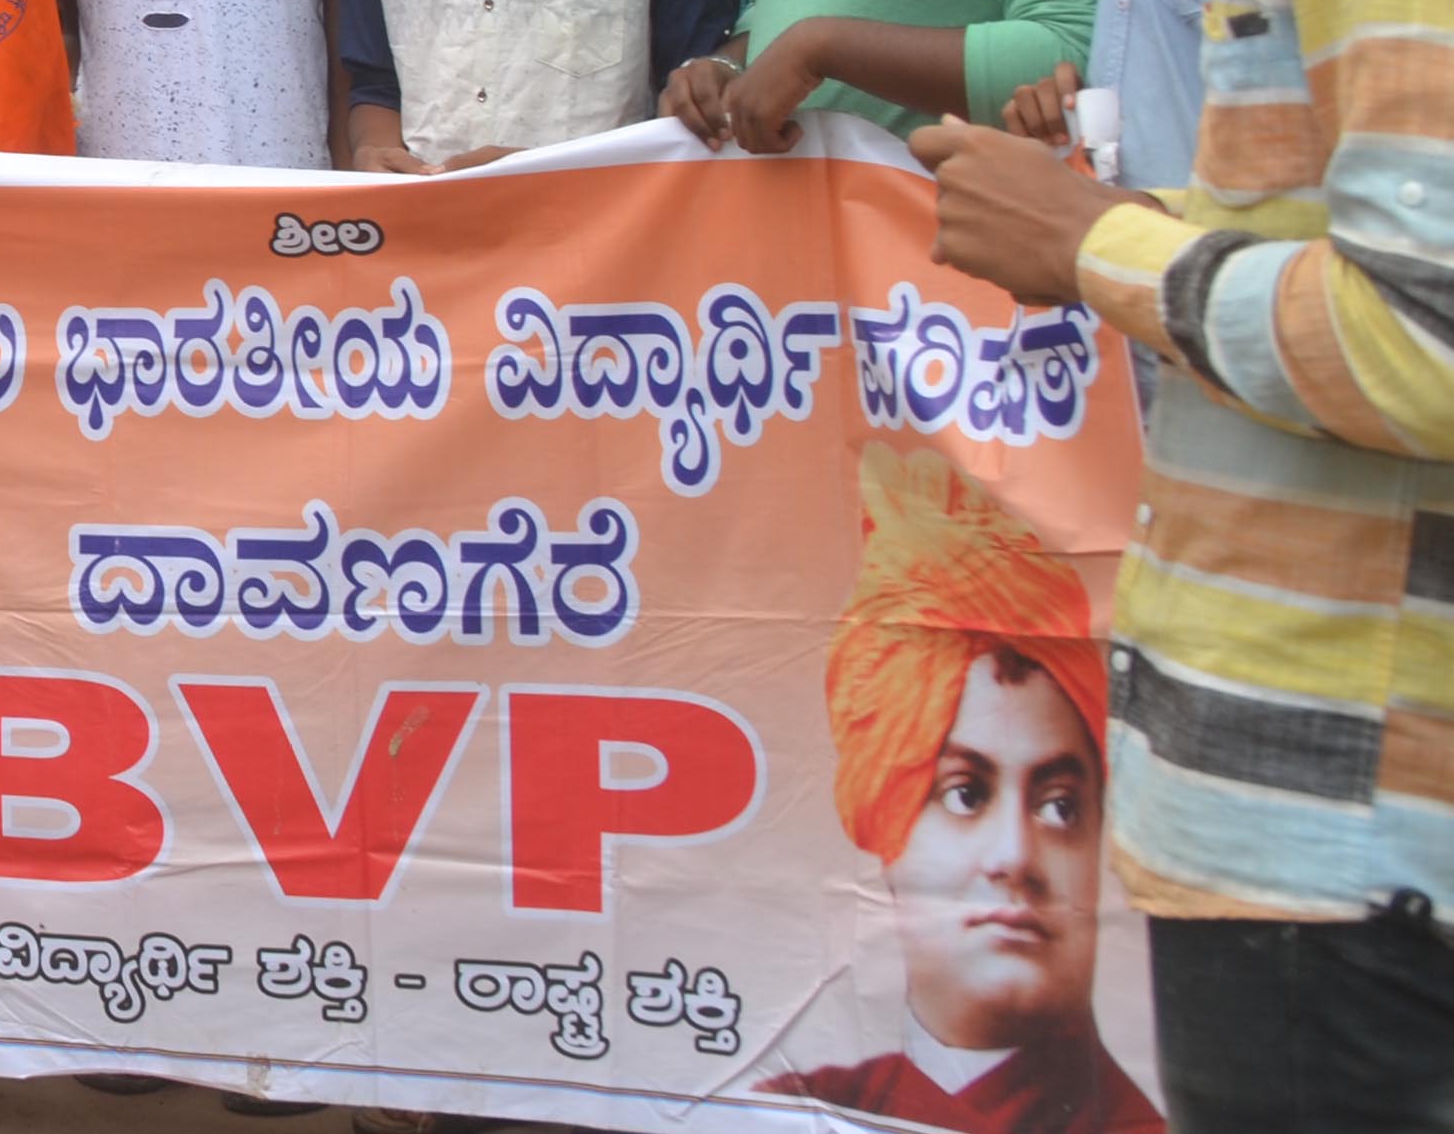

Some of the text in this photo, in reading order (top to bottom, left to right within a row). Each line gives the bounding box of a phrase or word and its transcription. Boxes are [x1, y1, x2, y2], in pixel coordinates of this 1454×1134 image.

[269, 212, 384, 257] ಶೀಲ
[62, 284, 442, 435] ಭಾರತೀಯ
[492, 291, 840, 491] ವಿದ್ಯಾರ್ಥಿ
[73, 504, 631, 638] ದಾವಣಗೆರೆ
[256, 932, 369, 1023] ಶಕ್ತಿ
[453, 950, 610, 1060] ರಾಷ್ಟ್ರ
[627, 956, 743, 1057] ಶಕ್ತಿ
